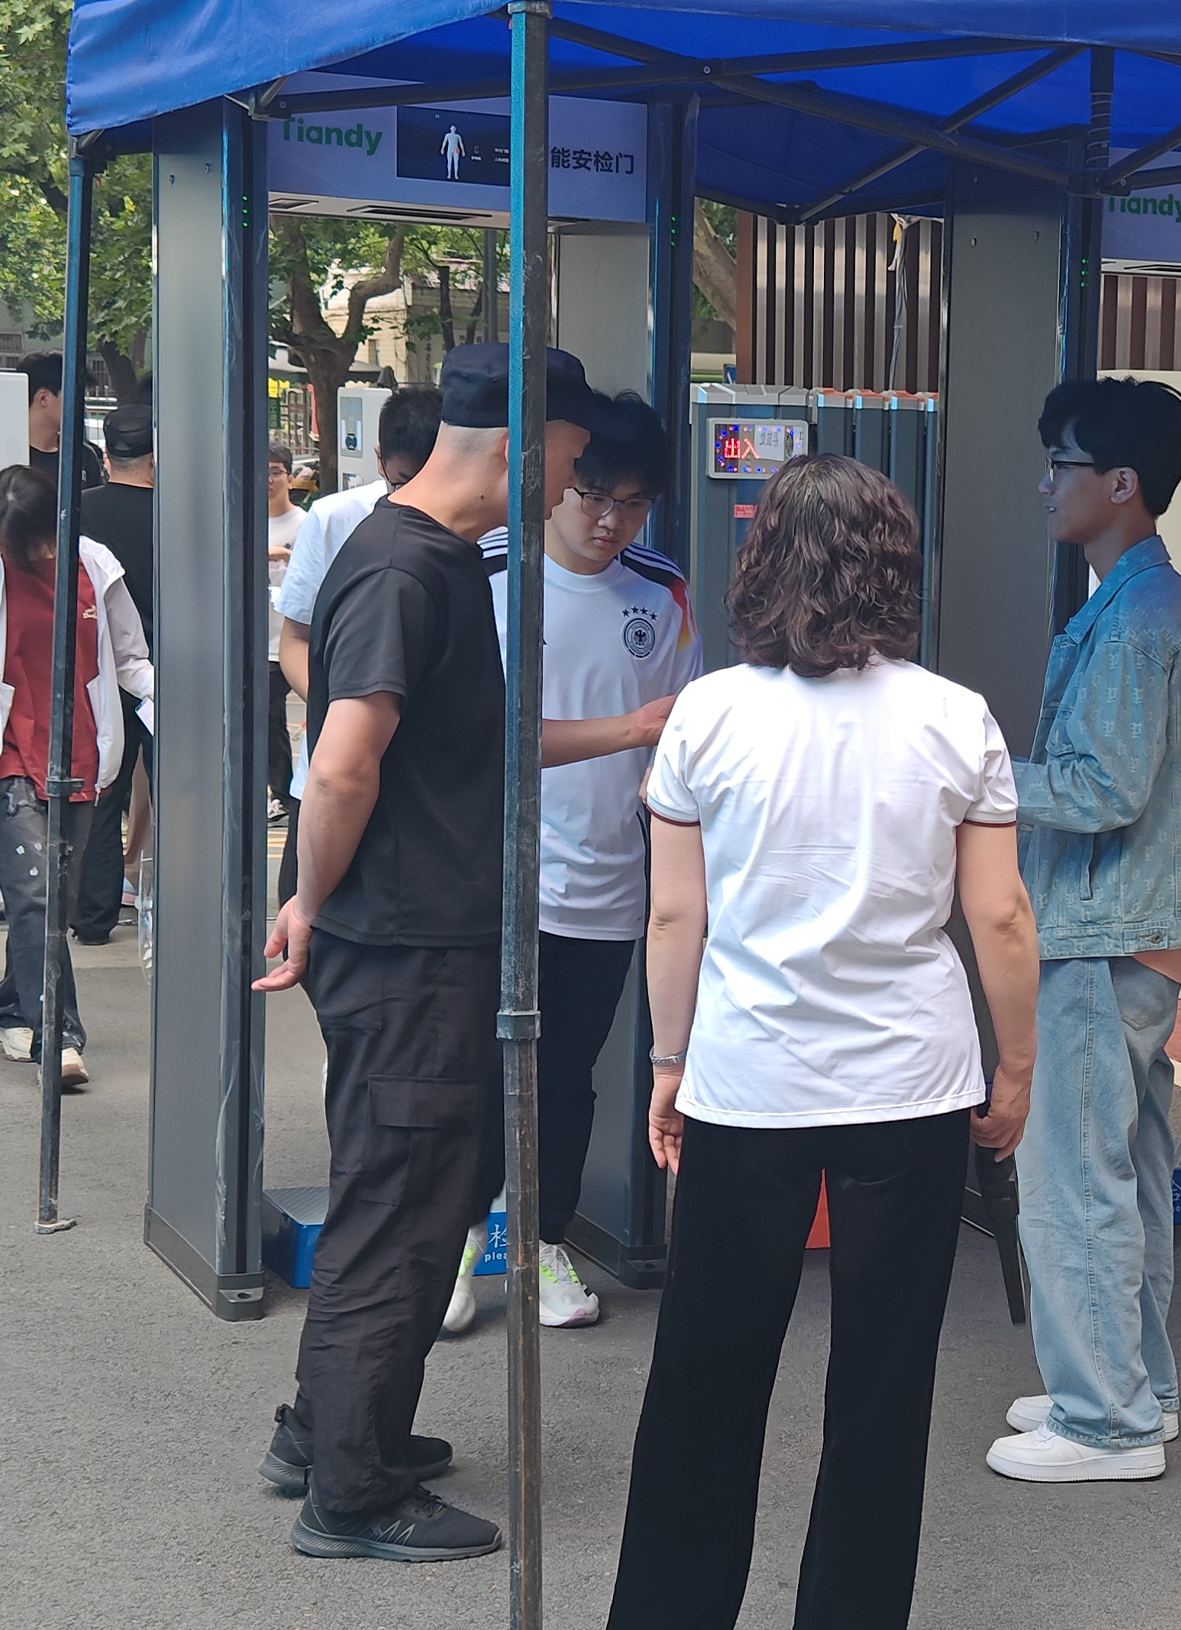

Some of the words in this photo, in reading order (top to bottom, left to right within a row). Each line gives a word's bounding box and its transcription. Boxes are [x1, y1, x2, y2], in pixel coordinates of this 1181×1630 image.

[282, 116, 383, 156] Tiandy
[550, 146, 635, 175] 能安检门
[723, 437, 760, 460] 出入
